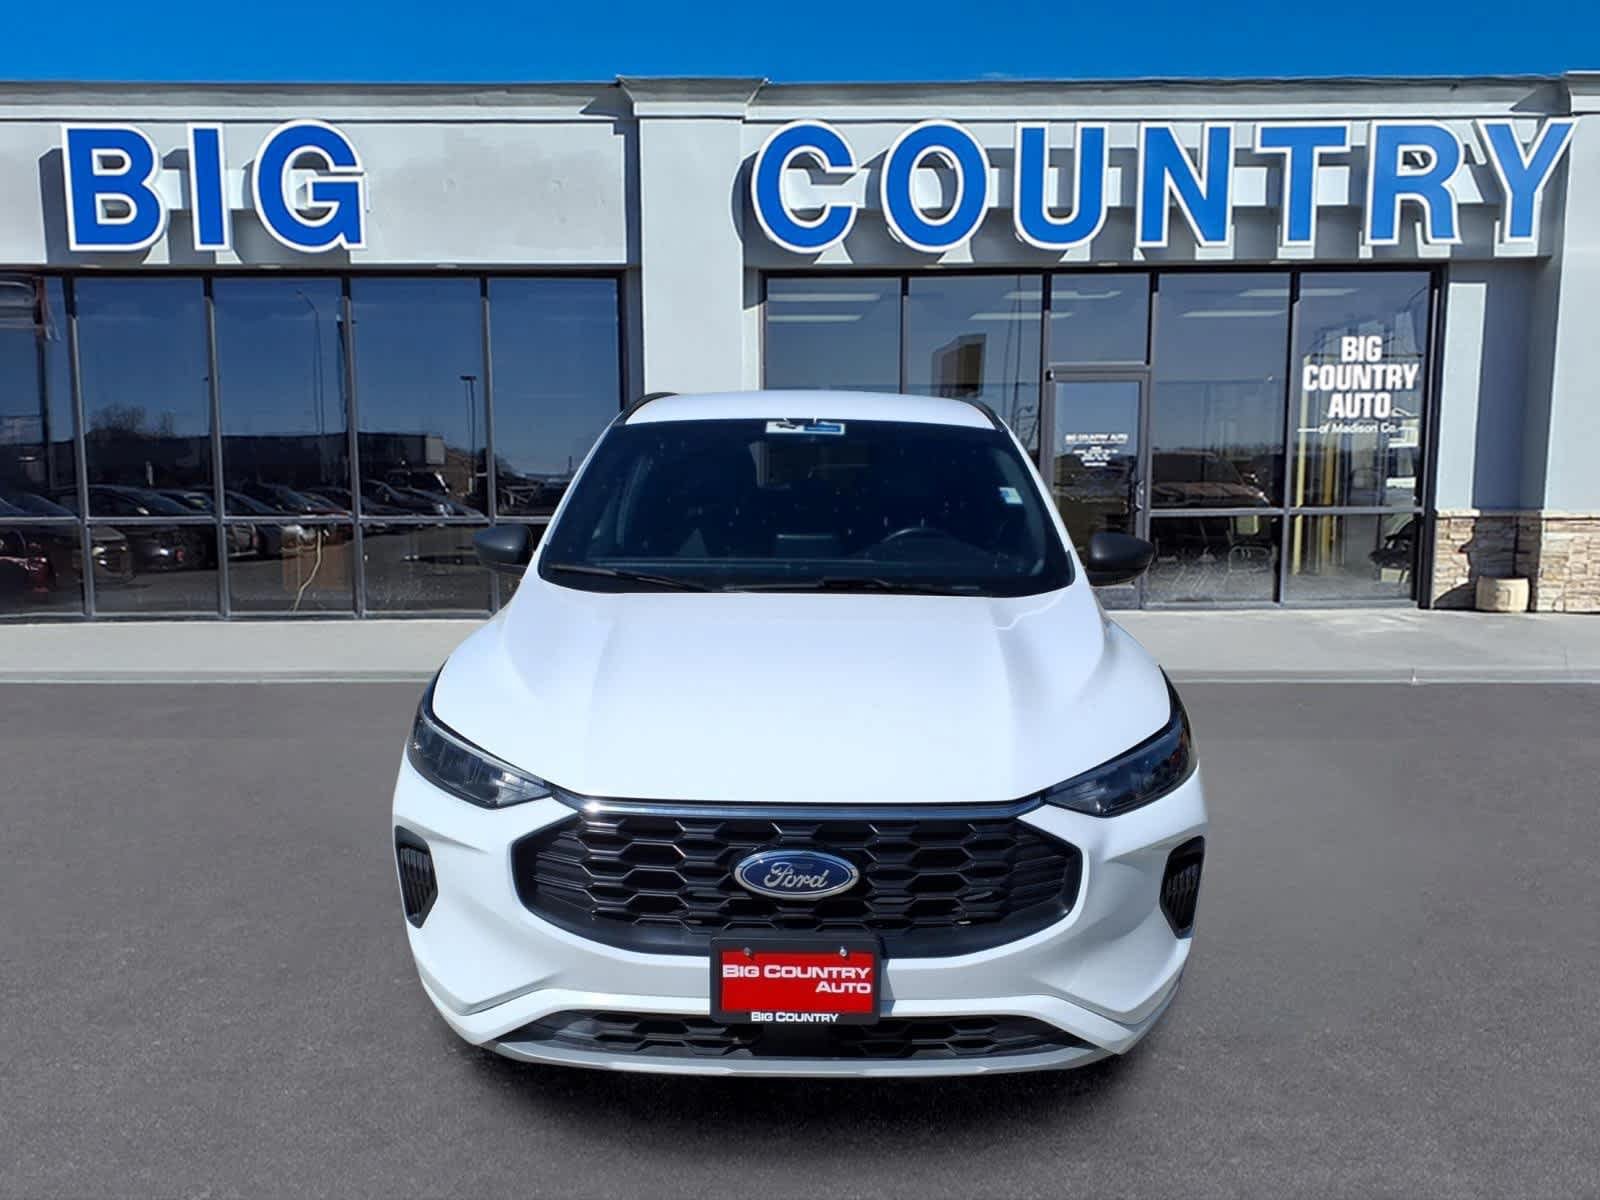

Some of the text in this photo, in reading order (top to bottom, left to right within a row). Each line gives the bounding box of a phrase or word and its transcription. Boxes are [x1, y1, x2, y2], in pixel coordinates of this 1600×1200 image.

[62, 116, 1575, 253] BIG COUNTRY
[1341, 336, 1383, 362] BIG
[1302, 363, 1420, 391] COUNTRY
[1327, 392, 1391, 419] AUTO
[763, 861, 830, 888] Ford
[764, 965, 871, 979] COUNTRY
[815, 981, 872, 994] AUTO
[775, 1012, 839, 1023] COUNTRY
